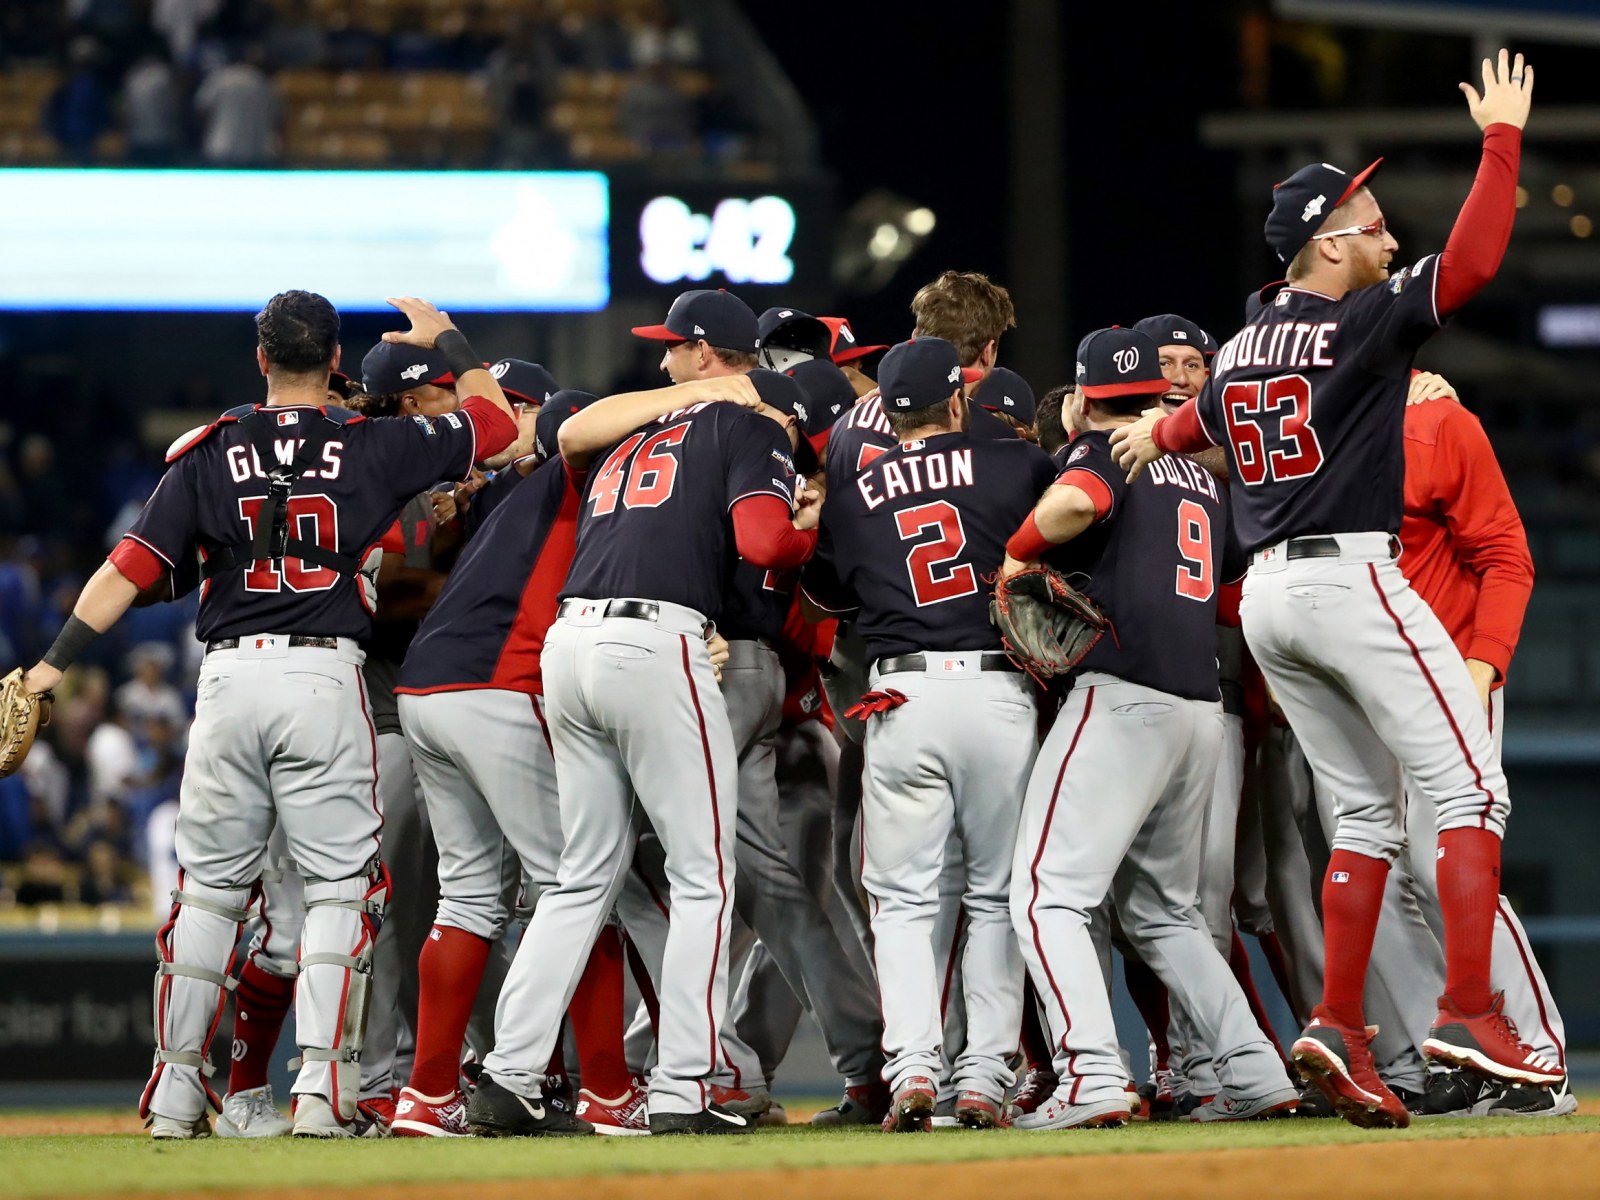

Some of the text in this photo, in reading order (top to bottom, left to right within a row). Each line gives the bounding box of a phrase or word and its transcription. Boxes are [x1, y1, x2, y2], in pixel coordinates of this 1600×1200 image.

[640, 196, 796, 284] 8:42
[587, 420, 693, 518] 46
[857, 449, 975, 510] EATON
[1221, 374, 1325, 486] 63
[238, 493, 341, 593] 10
[893, 499, 979, 608] 2
[1176, 498, 1215, 602] 9
